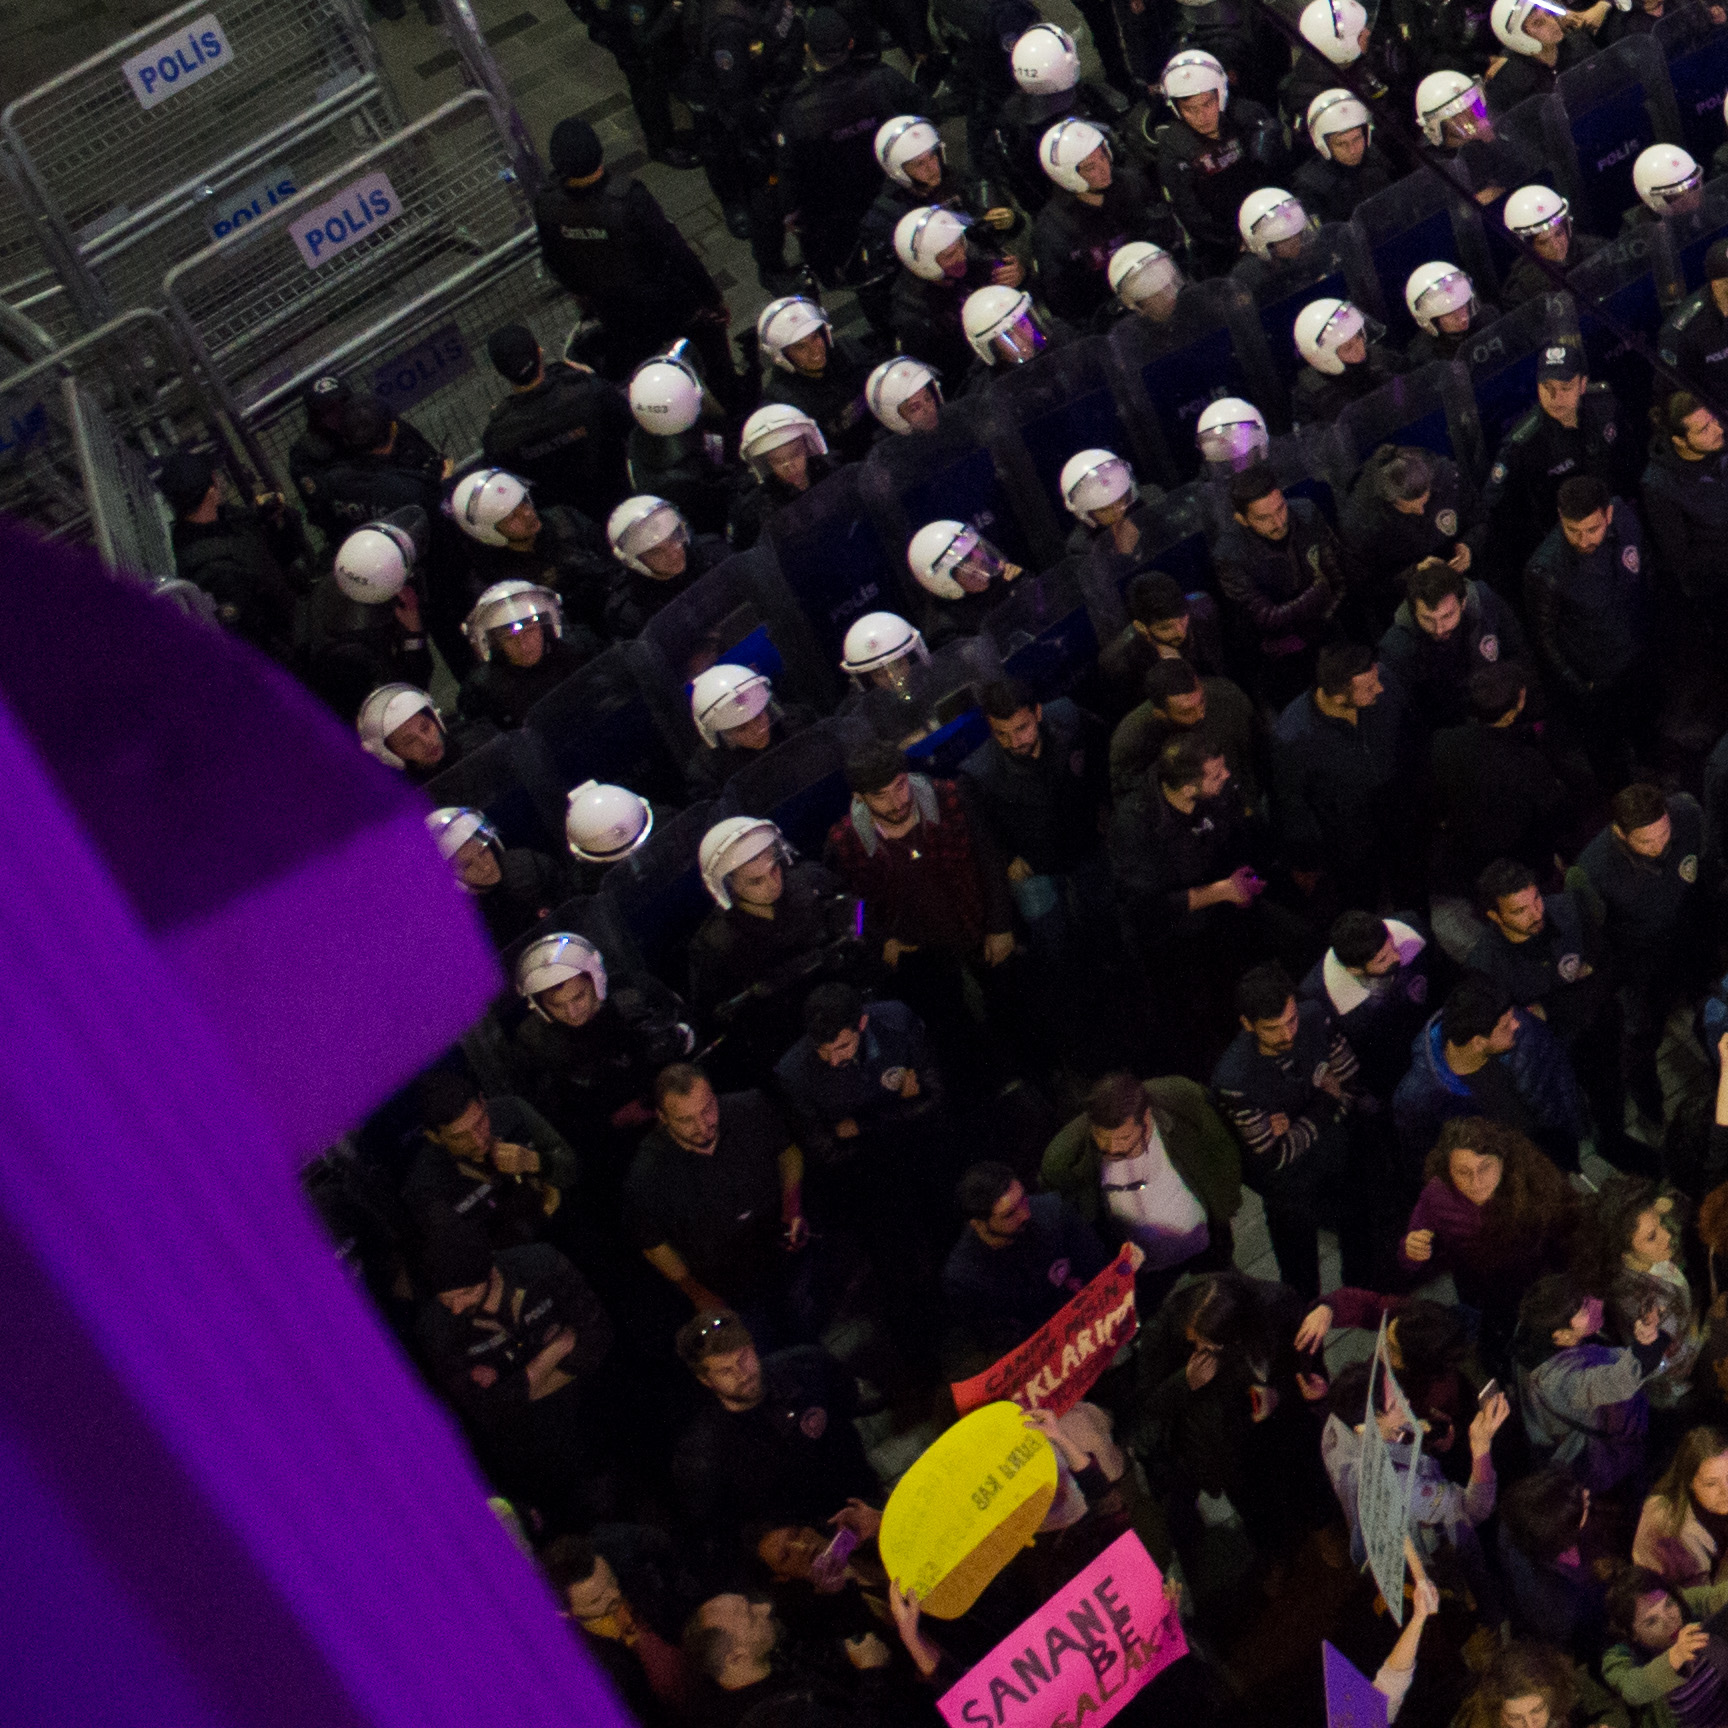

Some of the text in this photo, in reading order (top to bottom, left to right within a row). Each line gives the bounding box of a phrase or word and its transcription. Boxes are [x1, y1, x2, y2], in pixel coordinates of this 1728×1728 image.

[139, 31, 221, 93] POLİS
[304, 185, 392, 257] POLİS
[961, 1575, 1134, 1728] SANANE
